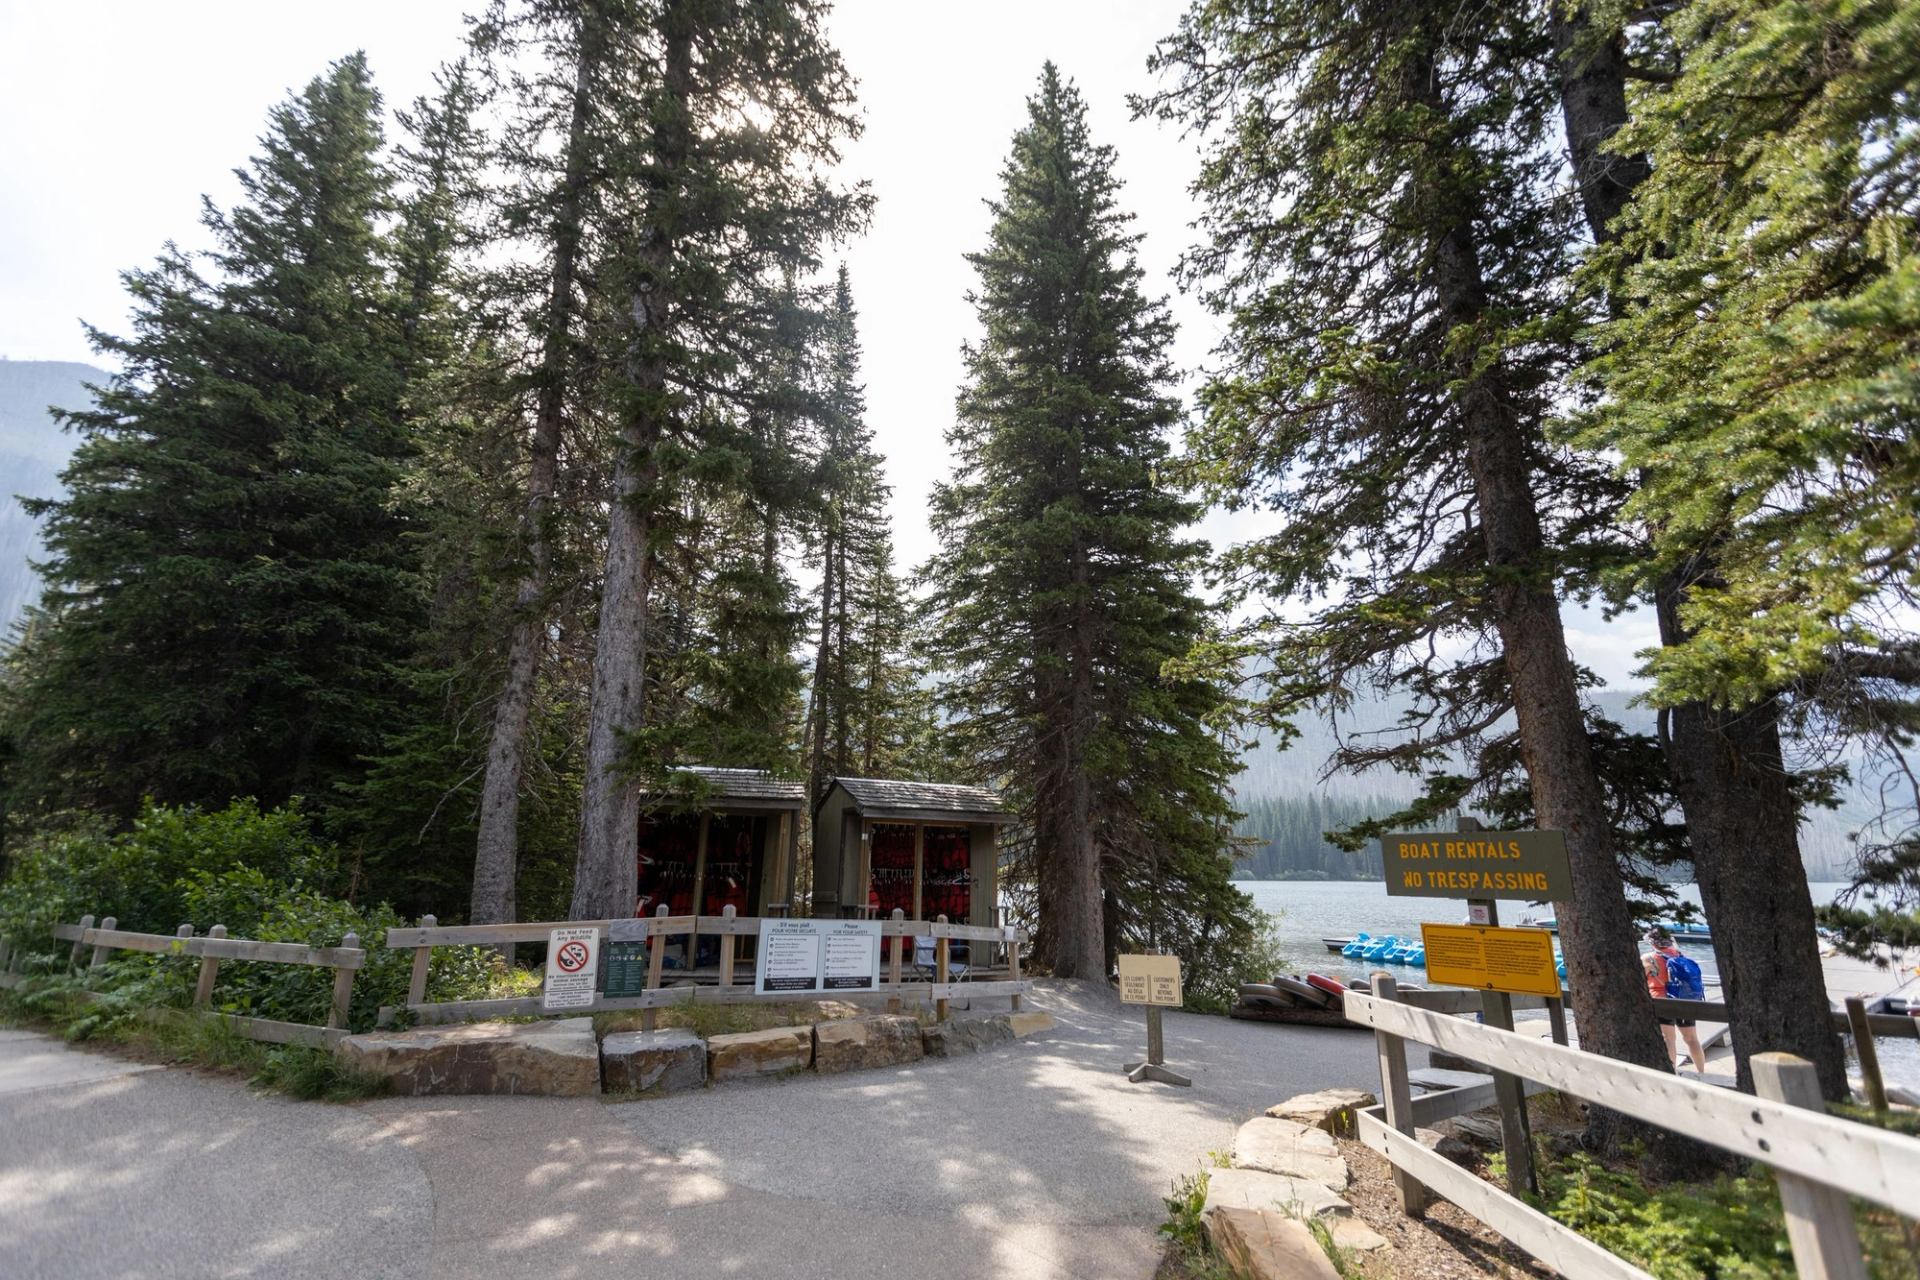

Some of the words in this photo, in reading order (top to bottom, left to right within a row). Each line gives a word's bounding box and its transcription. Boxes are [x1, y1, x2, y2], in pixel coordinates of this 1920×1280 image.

[1400, 842, 1440, 859] BOAT
[1445, 841, 1521, 859] RENTALS
[1404, 872, 1422, 888] NO
[1427, 871, 1548, 890] TRESPASSING
